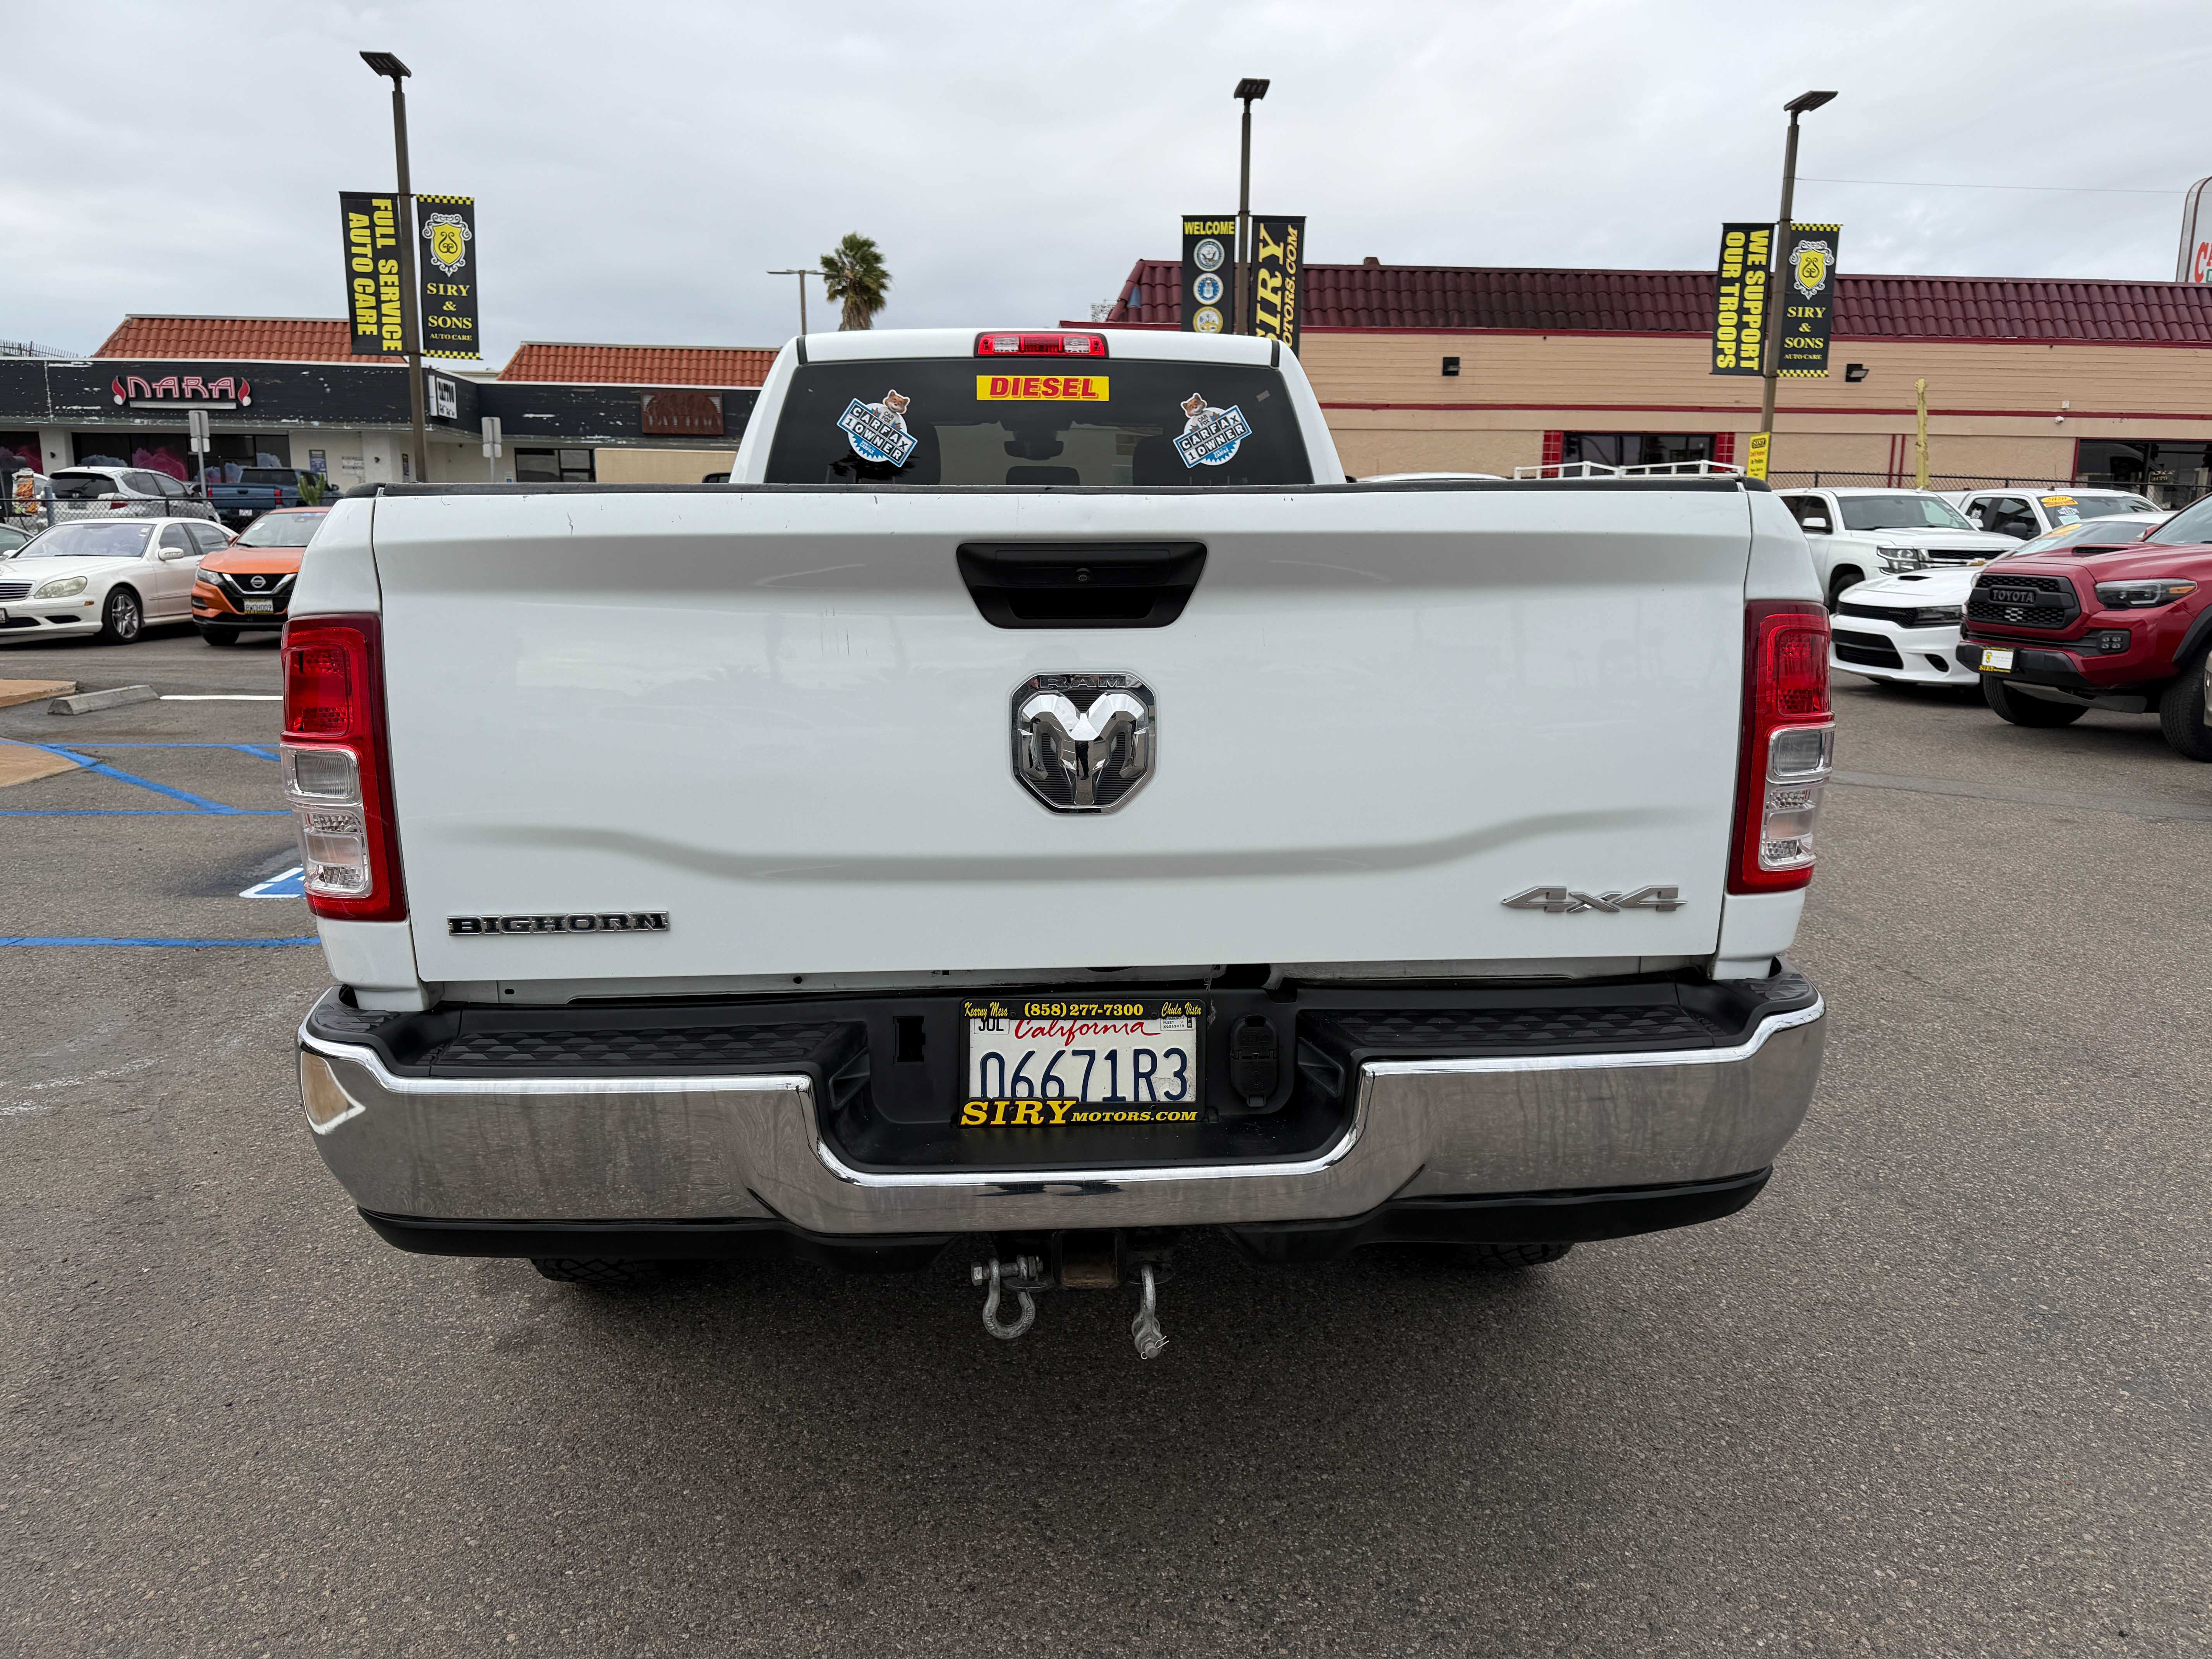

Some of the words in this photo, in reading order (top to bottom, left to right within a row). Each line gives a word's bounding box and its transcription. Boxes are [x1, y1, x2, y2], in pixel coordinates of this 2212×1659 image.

[372, 199, 396, 249] FULL
[1184, 222, 1235, 235] WELCOME
[349, 212, 375, 273] AUTO
[1722, 232, 1745, 278] OUR
[1747, 230, 1769, 266] WE
[427, 283, 471, 296] SIRY
[1283, 225, 1298, 347] OTORS.COM
[353, 278, 378, 335] CARE
[378, 259, 402, 351] SERVICE
[442, 301, 457, 311] &
[1787, 307, 1826, 318] SIRY
[428, 316, 472, 329] SONS
[1716, 283, 1740, 368] TROOPS
[1739, 270, 1765, 371] SUPPORT
[1798, 323, 1812, 332] &
[1784, 337, 1824, 349] SONS
[126, 376, 236, 399] NARA
[990, 377, 1098, 399] DIESEL
[846, 418, 852, 427] 1
[855, 424, 902, 460] OWNER
[853, 407, 908, 450] CARFAX
[1182, 415, 1239, 449] CARFAX
[1197, 425, 1245, 455] OWNER
[1993, 590, 2035, 603] TOYOTA
[1039, 676, 1127, 688] RAM
[447, 911, 670, 936] BIGHORN
[964, 1002, 988, 1021] Kearny
[990, 1001, 1008, 1017] Mesa
[1024, 1002, 1066, 1017] (858)
[1070, 1004, 1144, 1016] 277-7300
[1161, 1001, 1184, 1017] Chula
[1185, 1001, 1202, 1015] Vista
[978, 1019, 1004, 1032] JUL
[1014, 1020, 1161, 1046] California
[981, 1048, 1188, 1102] 06671R3
[960, 1100, 1077, 1125] SIRY
[1071, 1111, 1198, 1121] MOTORS.COM
